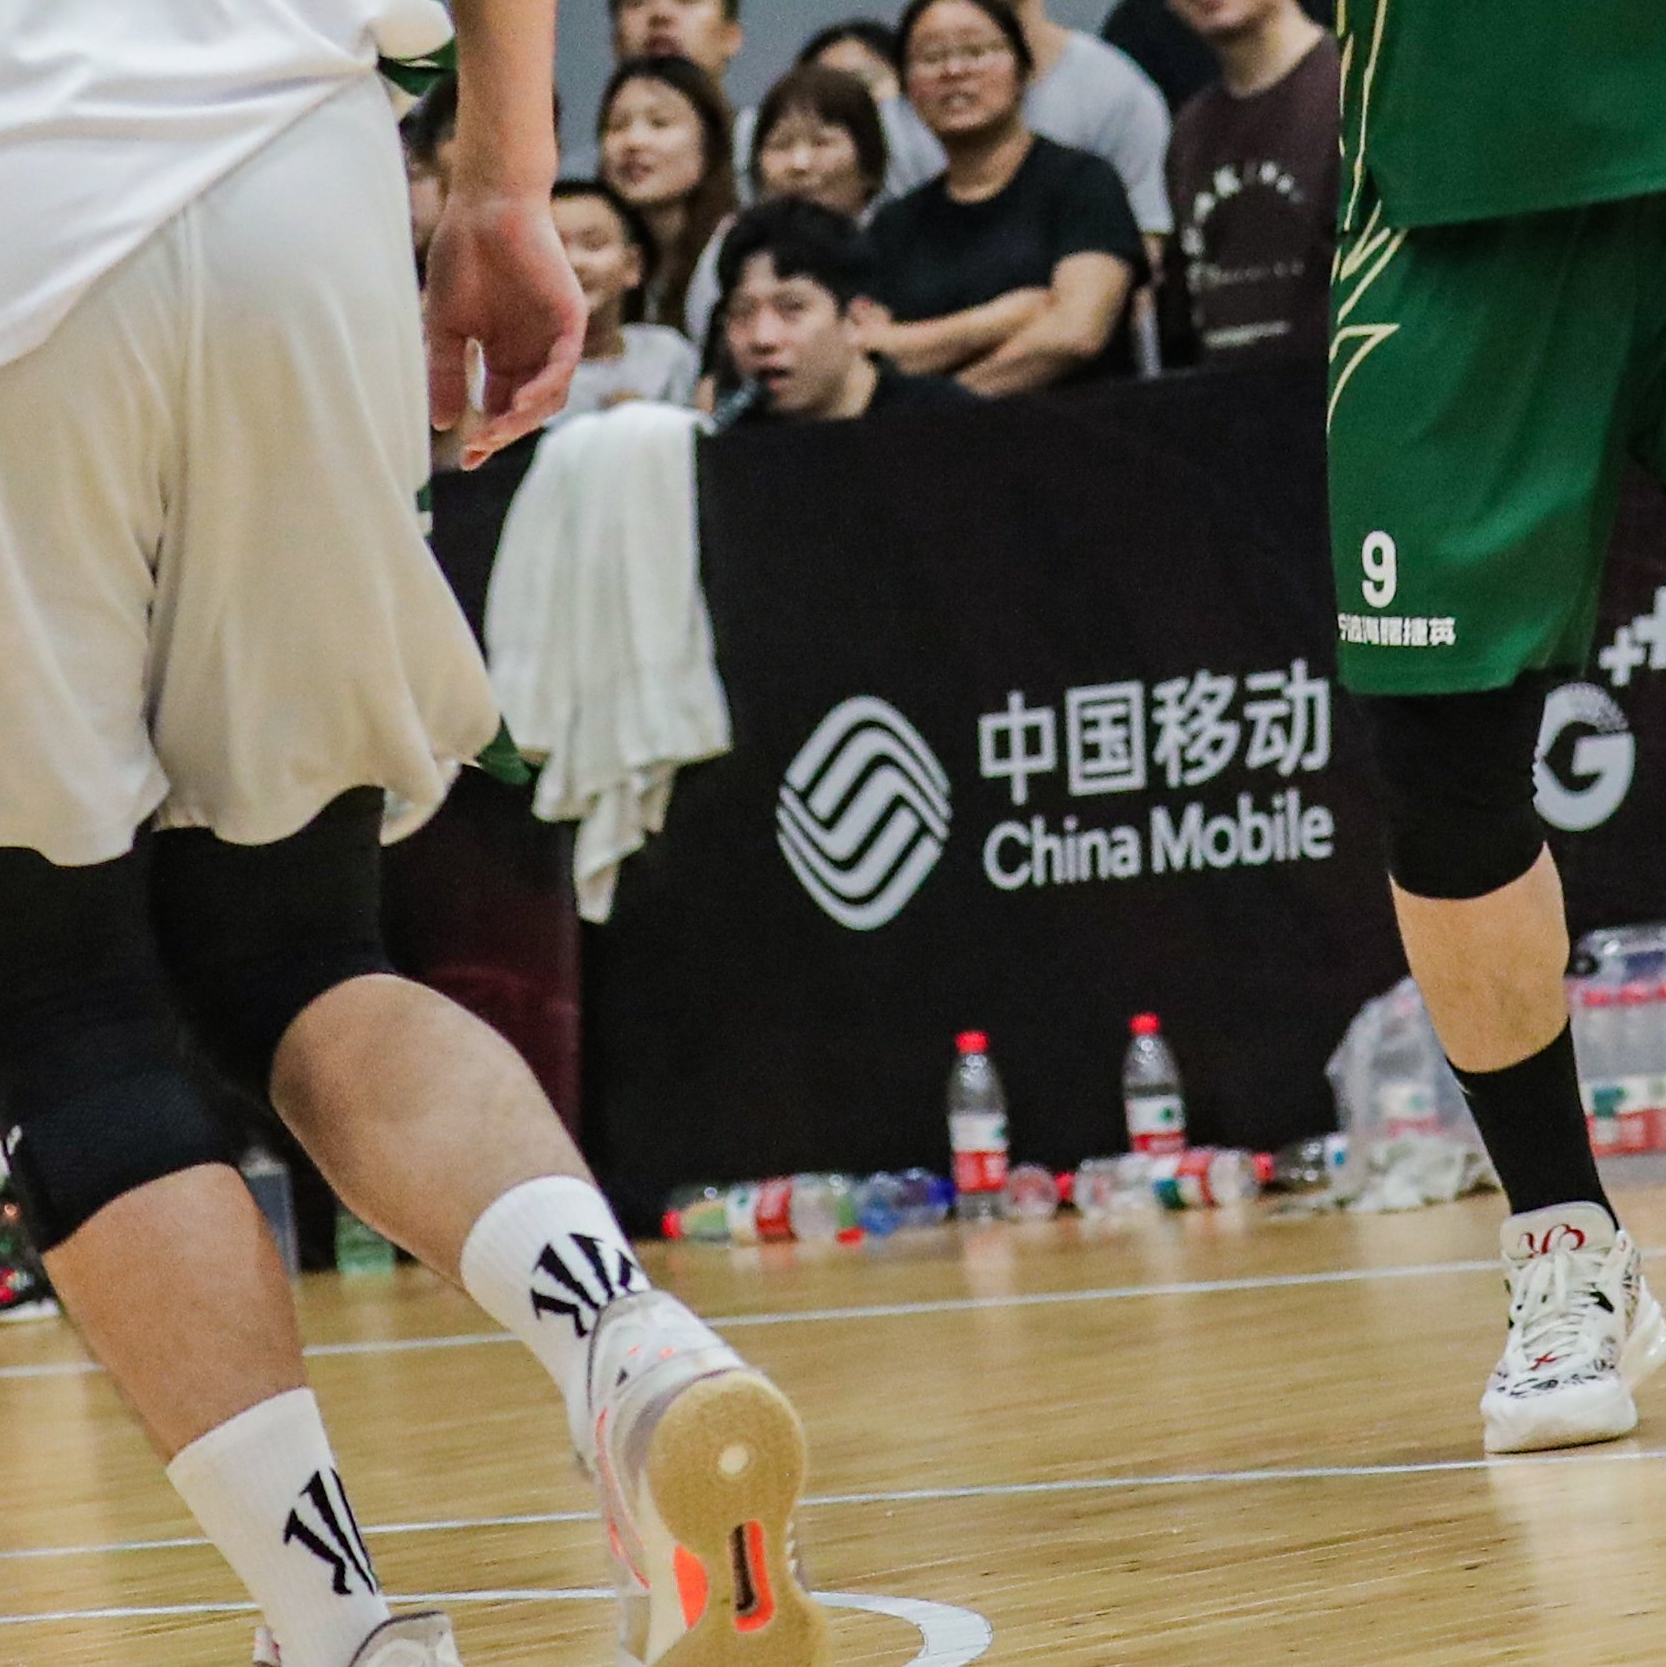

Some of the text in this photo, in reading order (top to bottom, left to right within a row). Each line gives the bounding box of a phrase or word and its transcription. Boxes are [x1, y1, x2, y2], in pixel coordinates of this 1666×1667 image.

[1361, 530, 1397, 608] 9
[978, 658, 1331, 806] 中国移动
[983, 788, 1335, 891] China Mobile
